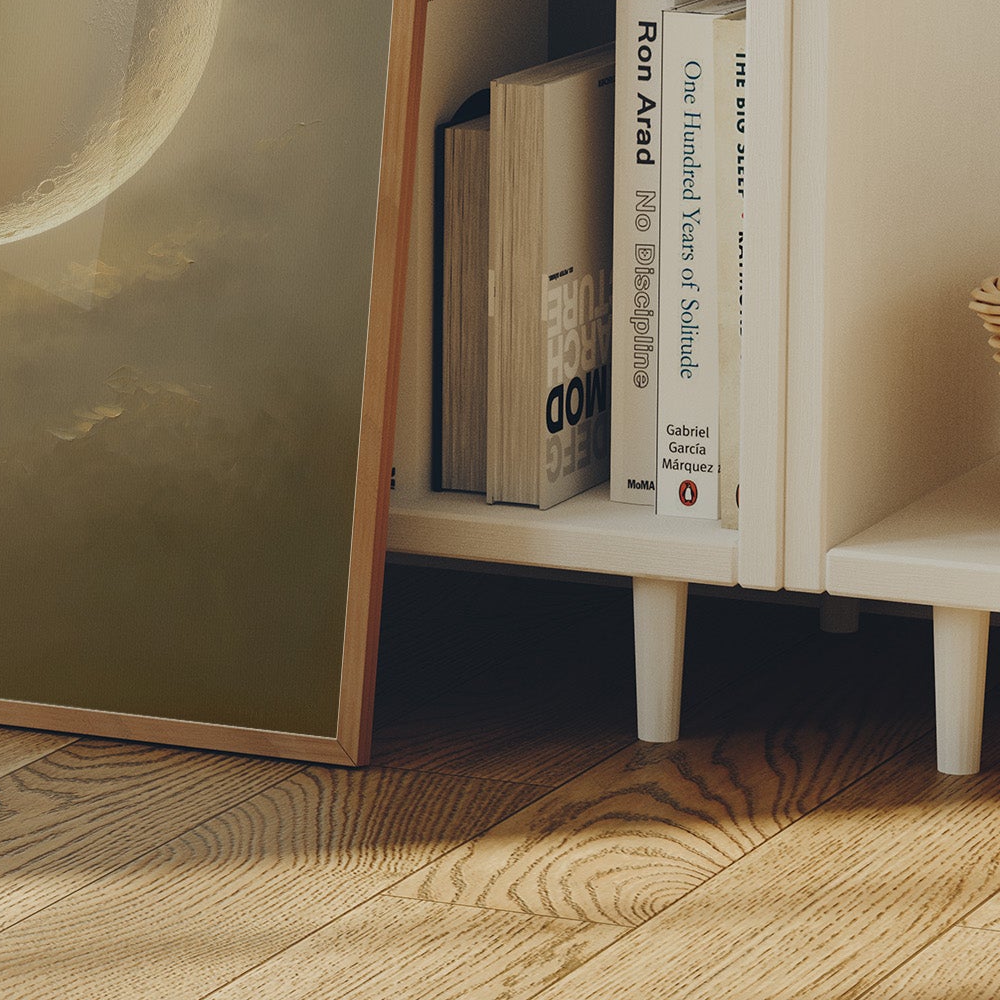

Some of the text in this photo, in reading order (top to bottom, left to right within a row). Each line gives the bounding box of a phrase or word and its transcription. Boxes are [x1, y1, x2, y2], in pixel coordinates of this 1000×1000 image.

[630, 20, 657, 389] Ron Arad No Discipline
[680, 60, 702, 379] One Hundred Years of Solitude
[666, 424, 710, 438] Gabriel
[668, 441, 706, 455] García
[662, 458, 714, 474] Márquez
[627, 479, 655, 491] MoMA
